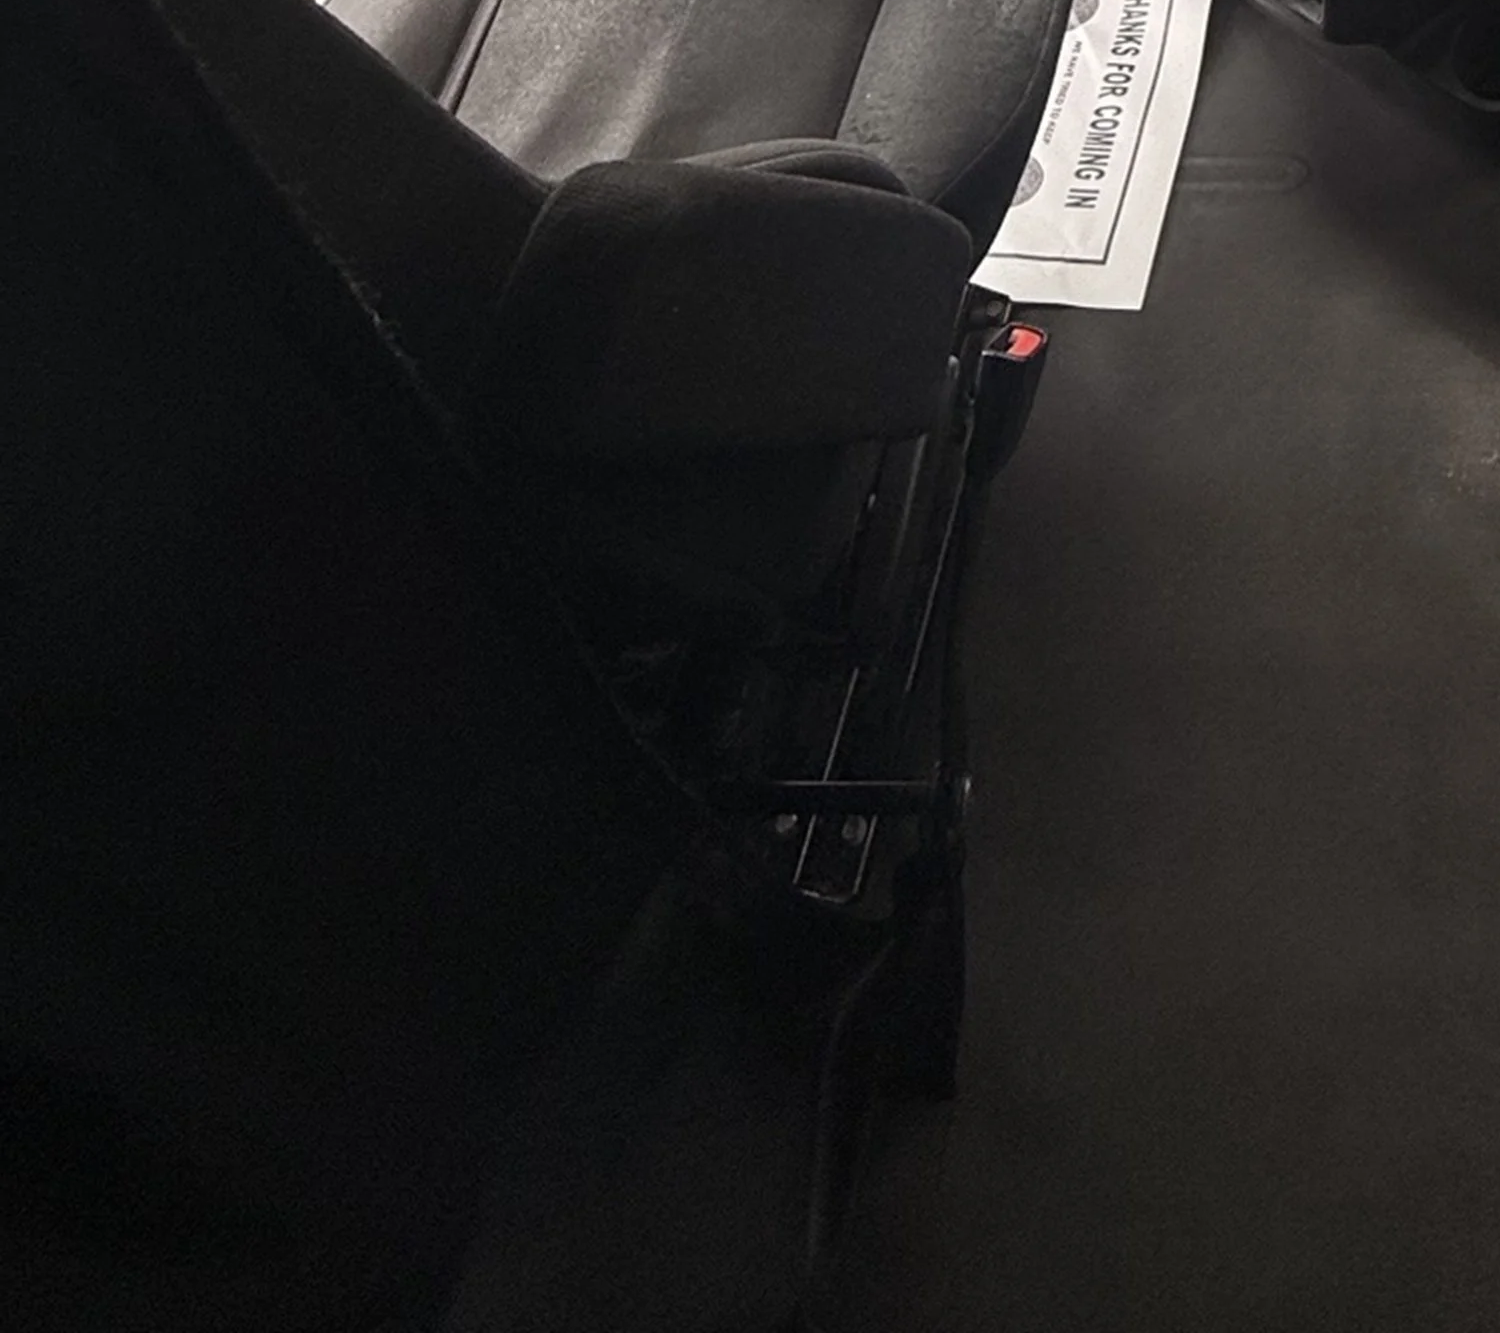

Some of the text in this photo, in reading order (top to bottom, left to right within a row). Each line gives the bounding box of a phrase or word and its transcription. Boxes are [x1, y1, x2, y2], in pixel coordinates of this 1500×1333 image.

[1097, 61, 1136, 100] FOR
[1073, 104, 1124, 181] COMING
[1063, 187, 1101, 209] IN
